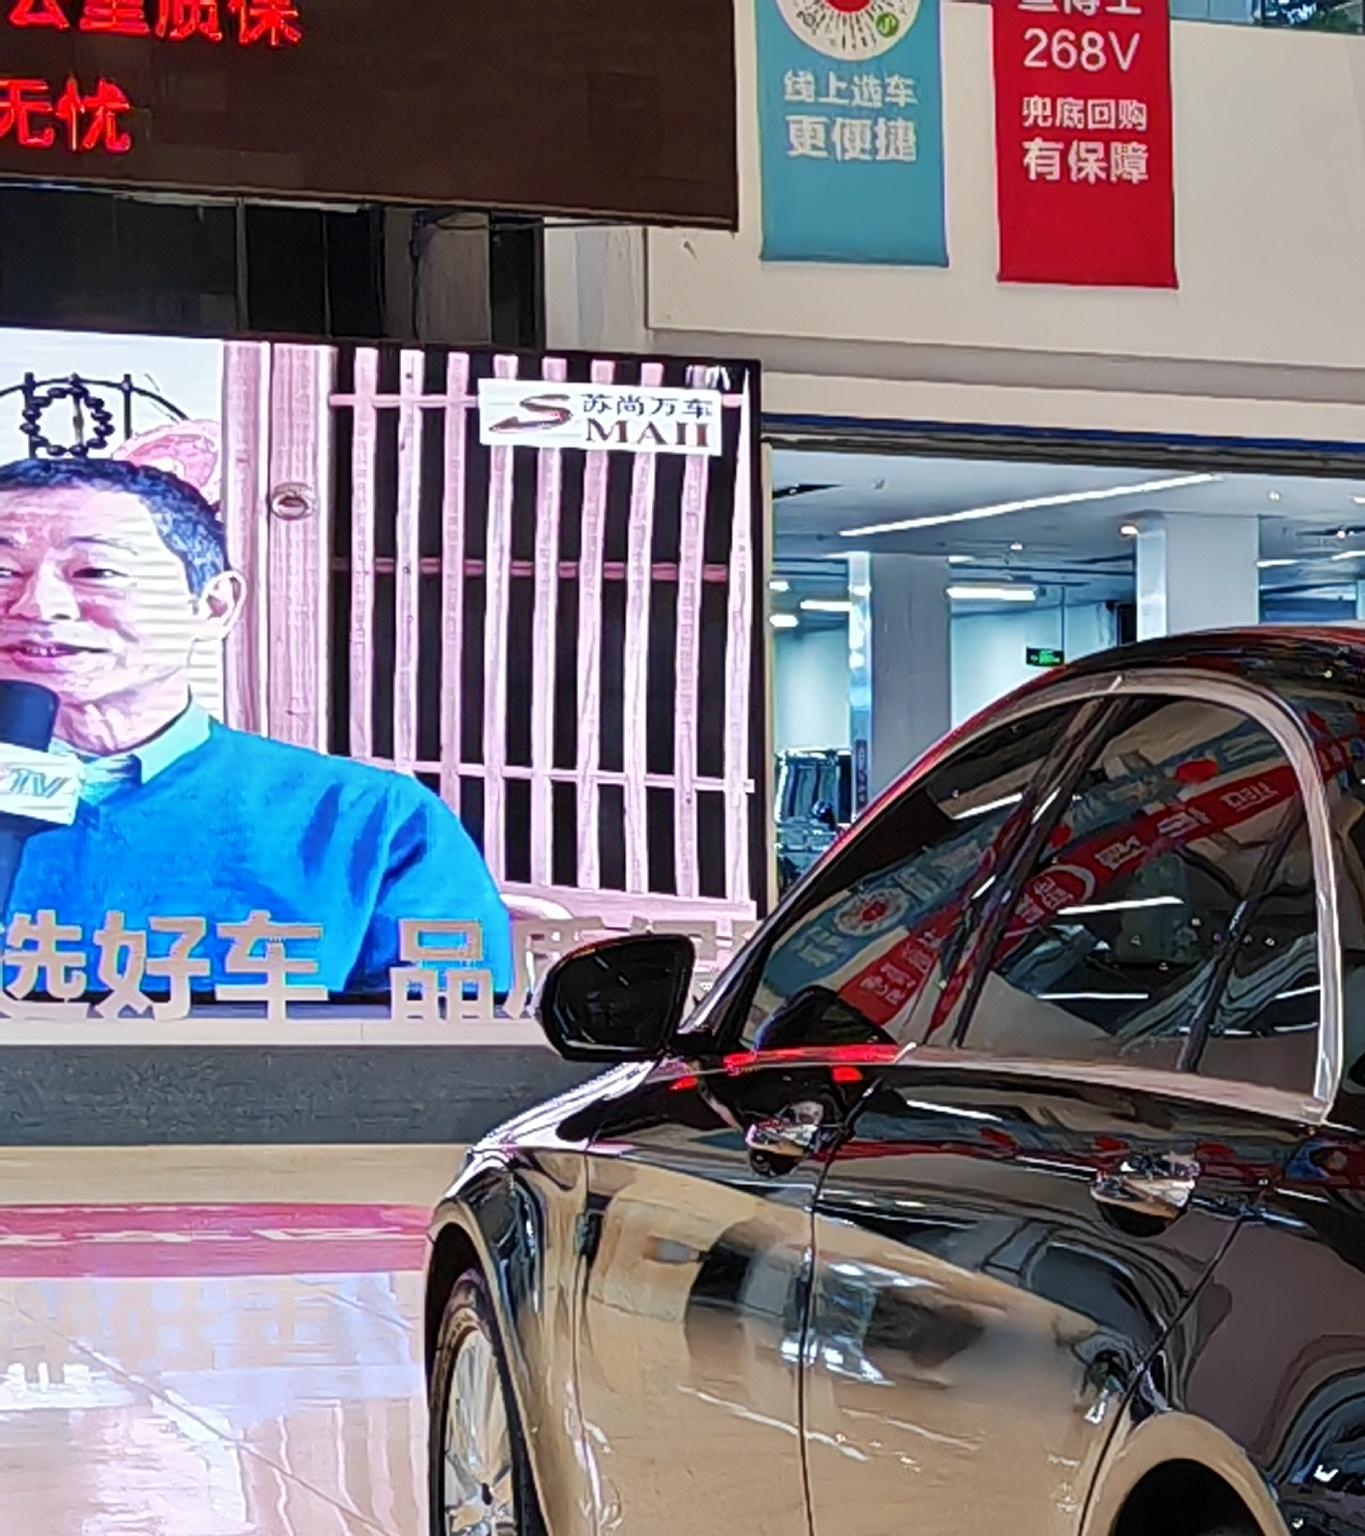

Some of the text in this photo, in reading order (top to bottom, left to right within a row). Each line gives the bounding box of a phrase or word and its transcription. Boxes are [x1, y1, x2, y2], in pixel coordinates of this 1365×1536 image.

[1023, 27, 1141, 72] 268V
[0, 74, 132, 152] 无忧
[783, 68, 918, 109] 线上选车
[1022, 95, 1147, 132] 兜底回购
[785, 114, 917, 163] 更便捷
[1022, 136, 1149, 185] 有保障
[0, 909, 330, 1022] 选好车
